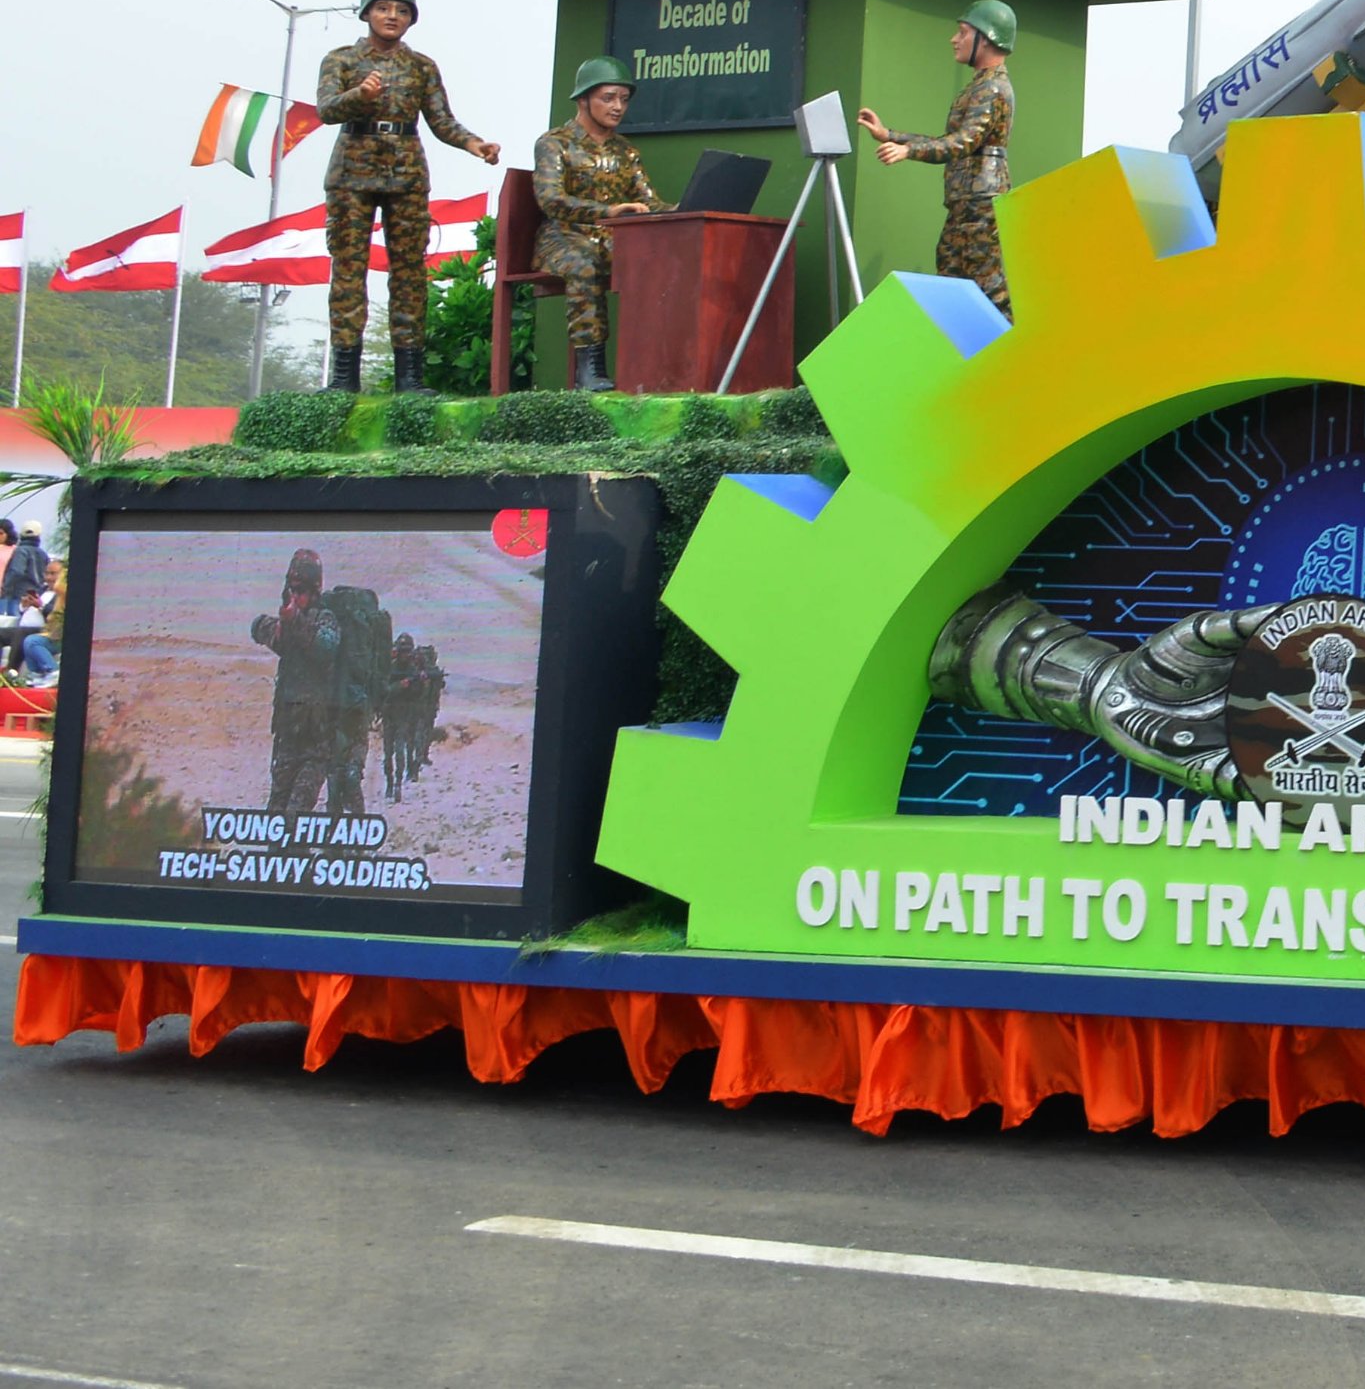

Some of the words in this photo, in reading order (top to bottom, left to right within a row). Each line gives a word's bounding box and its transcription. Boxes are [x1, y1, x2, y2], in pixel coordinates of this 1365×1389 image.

[633, 42, 770, 80] Transformation
[1262, 601, 1336, 648] INDIAN
[1275, 767, 1338, 793] भारतीय
[204, 812, 290, 848] YOUNG,
[294, 817, 332, 844] FIT
[330, 818, 385, 846] AND
[1059, 794, 1283, 850] INDIAN
[159, 851, 309, 884] TECH-SAVVY
[313, 859, 430, 891] SOLDIERS.
[796, 866, 880, 929] ON
[894, 871, 1045, 937] PATH
[1062, 878, 1147, 941] TO
